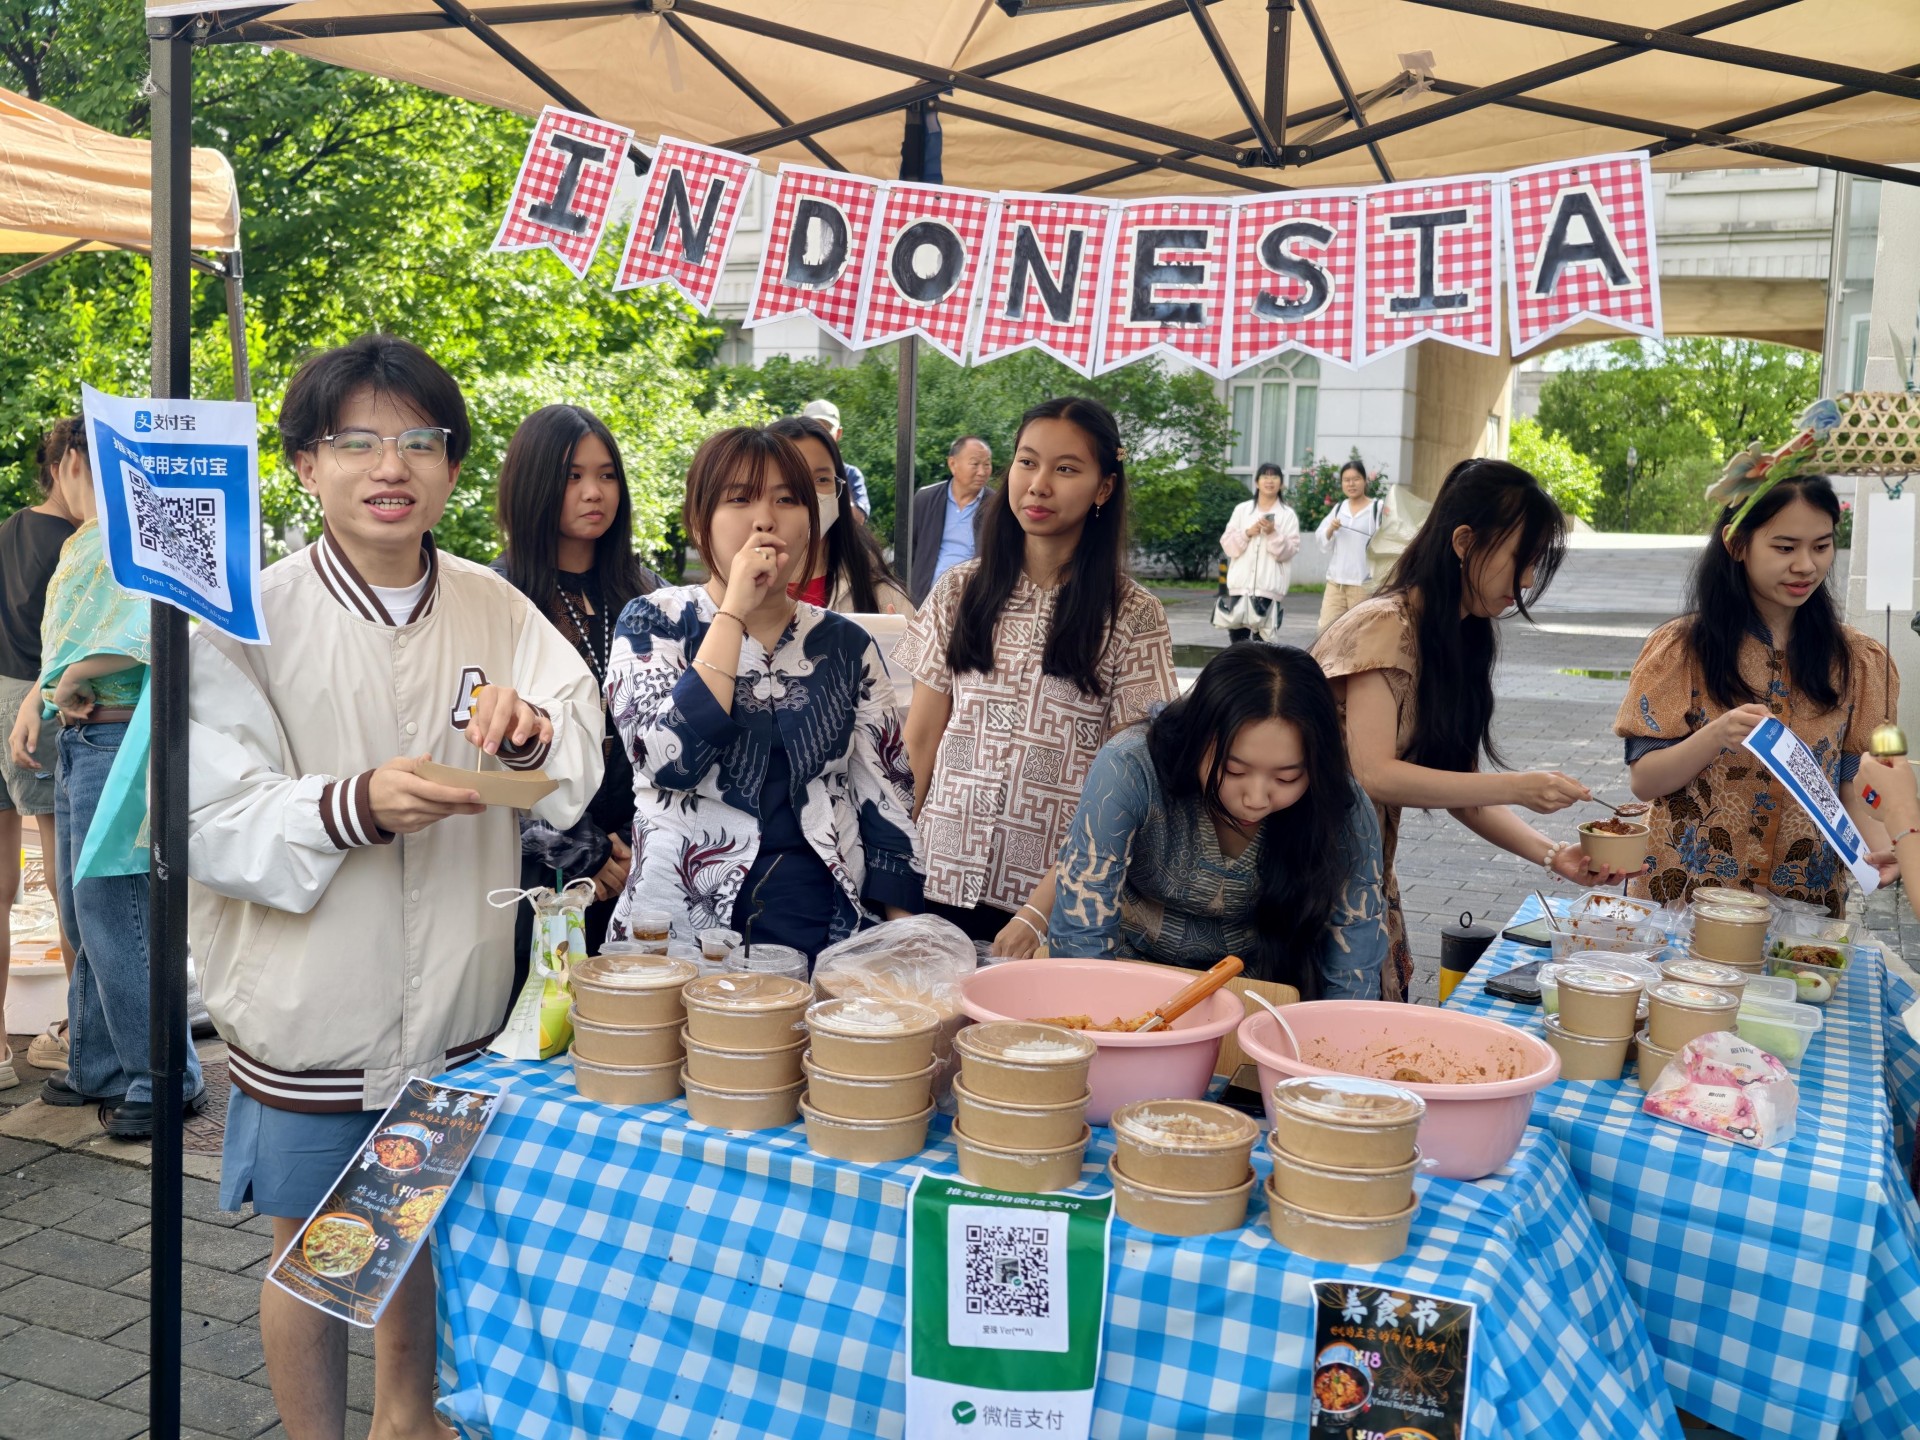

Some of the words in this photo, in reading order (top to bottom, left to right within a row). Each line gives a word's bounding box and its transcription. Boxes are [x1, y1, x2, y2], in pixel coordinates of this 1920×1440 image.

[526, 130, 1642, 328] INDONESIA
[153, 413, 196, 431] 支付宝
[142, 574, 164, 587] Open
[423, 1130, 445, 1144] ¥18
[399, 1185, 421, 1199] ¥10
[945, 1186, 1082, 1210] 推荐使用微信支付
[366, 1234, 391, 1251] ¥15
[1341, 1287, 1440, 1336] 美食节
[1354, 1350, 1382, 1368] ¥18
[982, 1404, 1065, 1431] 微信支付
